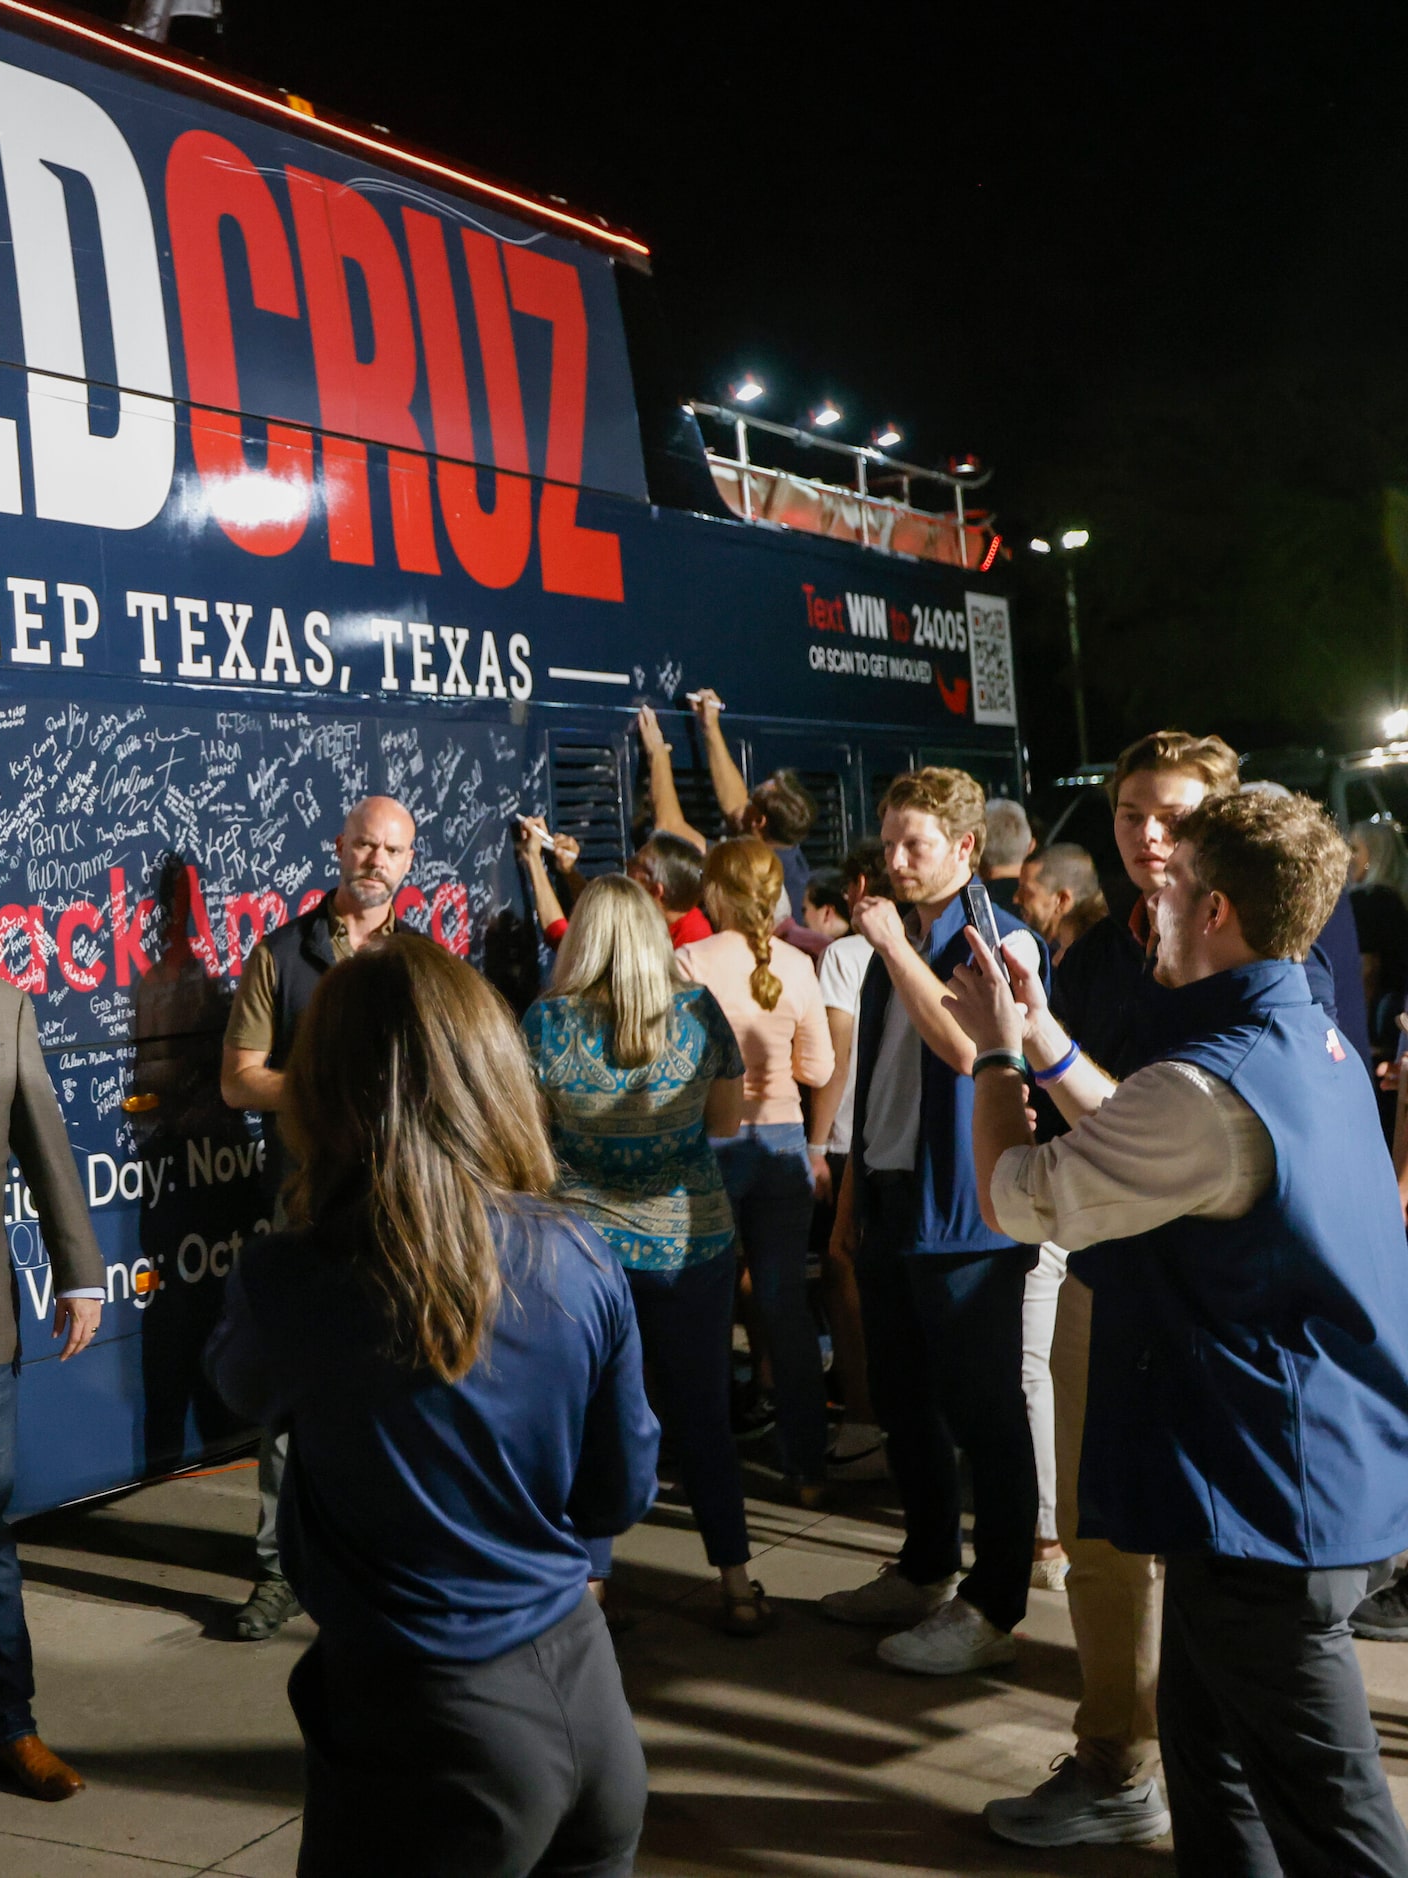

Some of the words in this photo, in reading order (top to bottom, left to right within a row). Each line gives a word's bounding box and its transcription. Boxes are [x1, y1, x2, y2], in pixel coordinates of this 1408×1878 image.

[164, 130, 625, 602] CRUZ
[127, 591, 352, 692] TEXAS,
[371, 618, 534, 700] TEXAS
[802, 583, 844, 632] Text
[845, 592, 888, 640] WIN
[890, 605, 911, 643] to
[911, 604, 968, 652] 24005
[809, 645, 826, 670] OR
[826, 648, 855, 674] SCAN
[855, 651, 869, 676] TO
[870, 653, 888, 678] GET
[889, 656, 932, 684] INVOLVED
[87, 1154, 175, 1208] Day:
